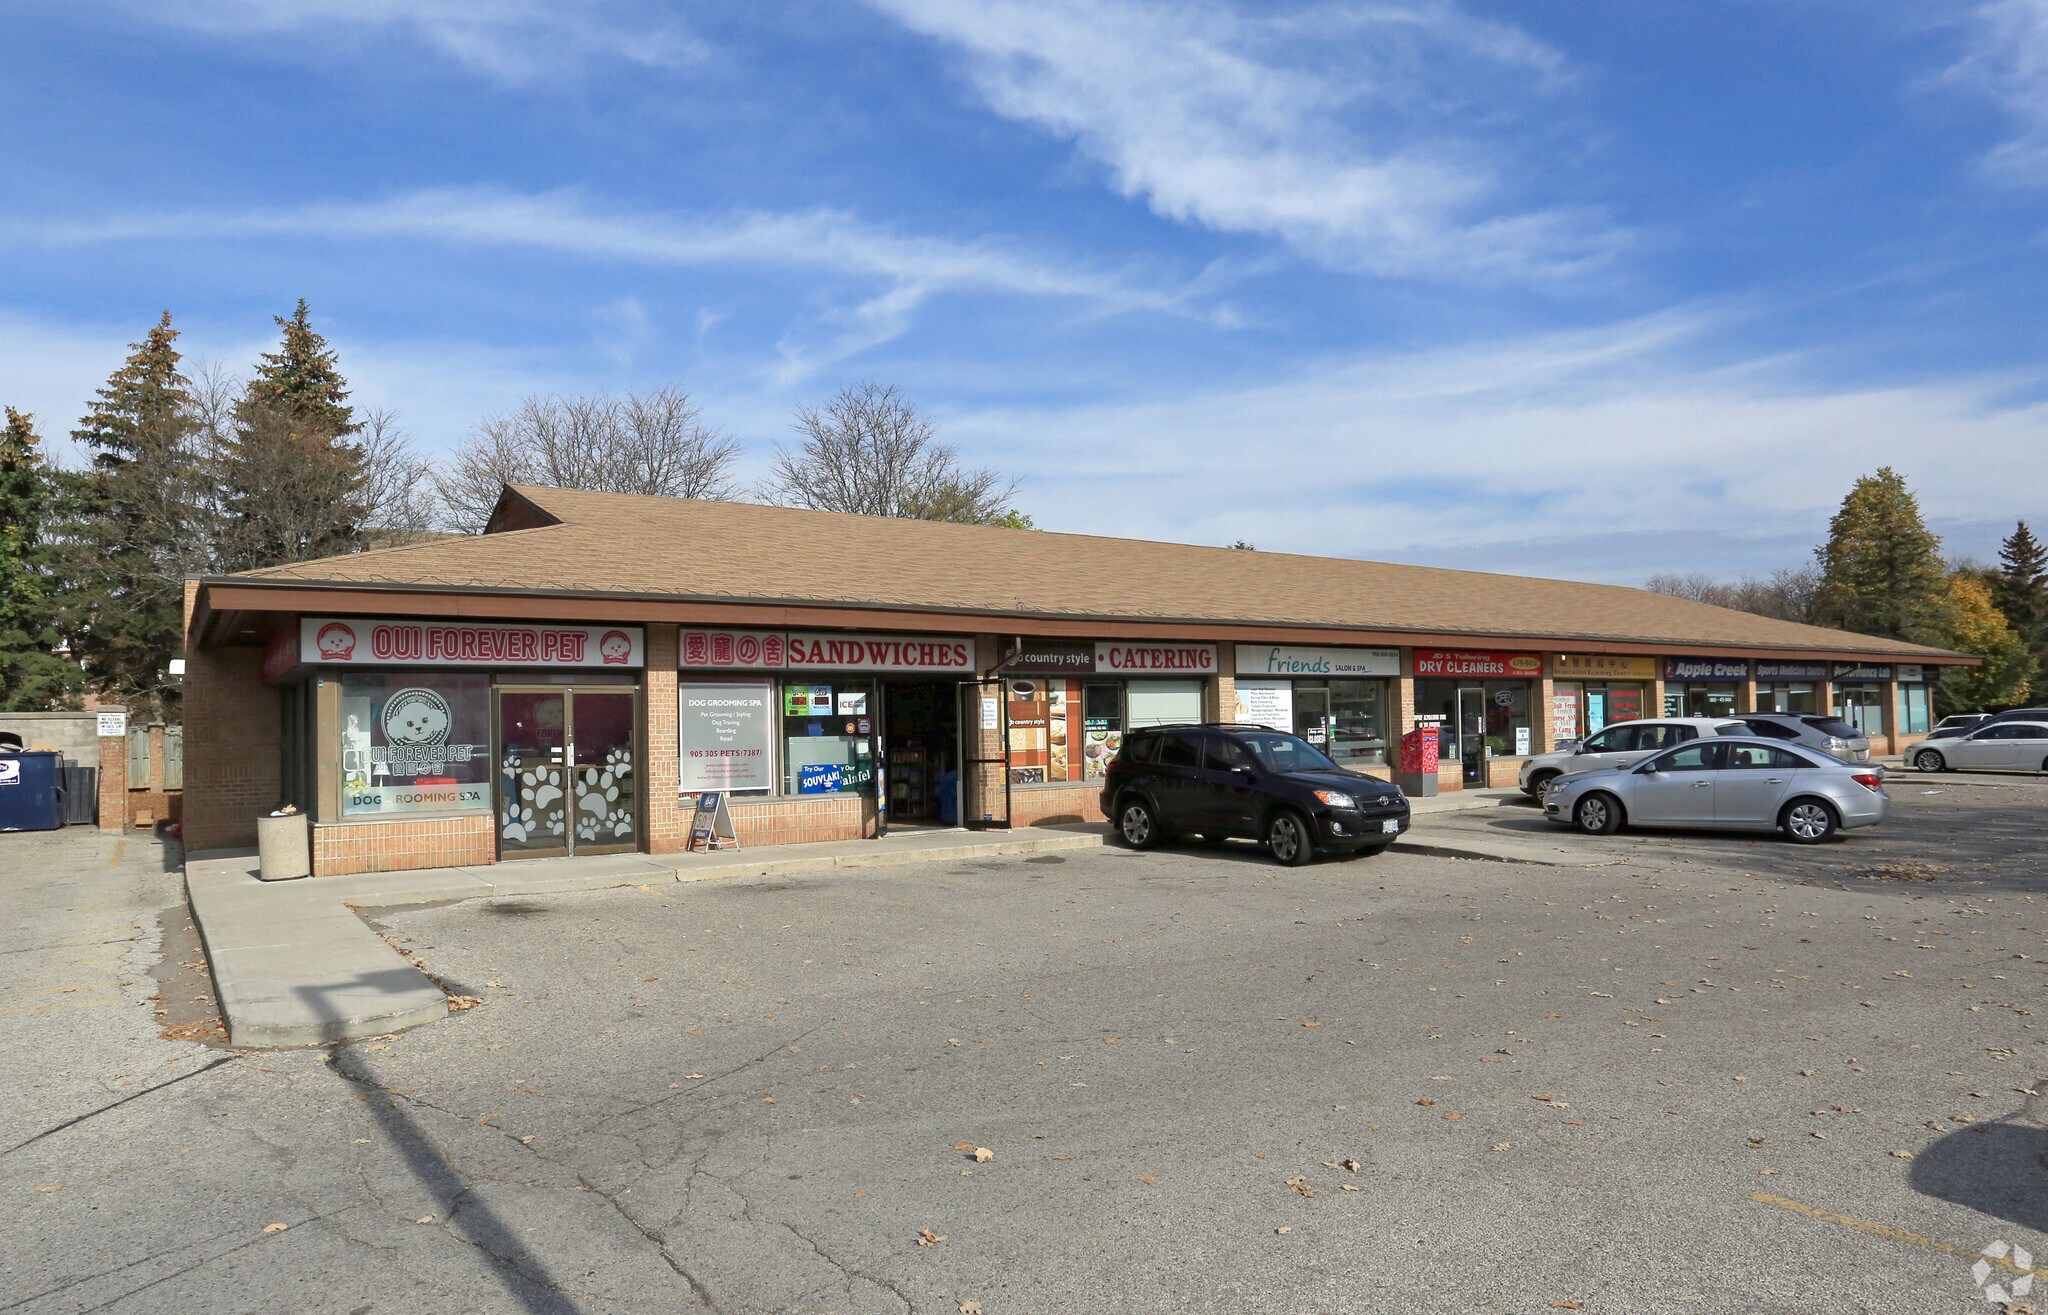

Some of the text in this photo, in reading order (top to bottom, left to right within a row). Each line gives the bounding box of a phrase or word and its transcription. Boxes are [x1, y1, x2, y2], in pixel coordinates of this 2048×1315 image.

[372, 626, 588, 662] OUI FOREVER PET
[789, 638, 968, 667] SANDWICHES
[1024, 652, 1090, 666] country style
[1109, 647, 1212, 669] CATERING
[1454, 653, 1490, 661] Tailoring
[1267, 647, 1331, 673] friends
[1420, 660, 1505, 674] DRY CLEANERS
[1335, 664, 1352, 672] SALON
[1554, 668, 1587, 676] Inspiration
[1587, 668, 1613, 677] Learning
[1675, 662, 1748, 678] Apple Creek
[1757, 664, 1779, 677] Sports
[1779, 665, 1806, 675] Medicine
[1878, 666, 1891, 678] Lab
[688, 699, 762, 707] DOG GROOMING SPA
[723, 719, 741, 727] Training
[716, 727, 737, 735] Boarding
[364, 744, 473, 763] OUI FOREVER PET
[690, 750, 703, 758] 905
[720, 749, 763, 757] PETS(7387)
[803, 770, 840, 788] SOUVLAKI
[840, 769, 871, 786] alafel
[353, 795, 382, 806] DOG
[459, 791, 481, 802] SPA
